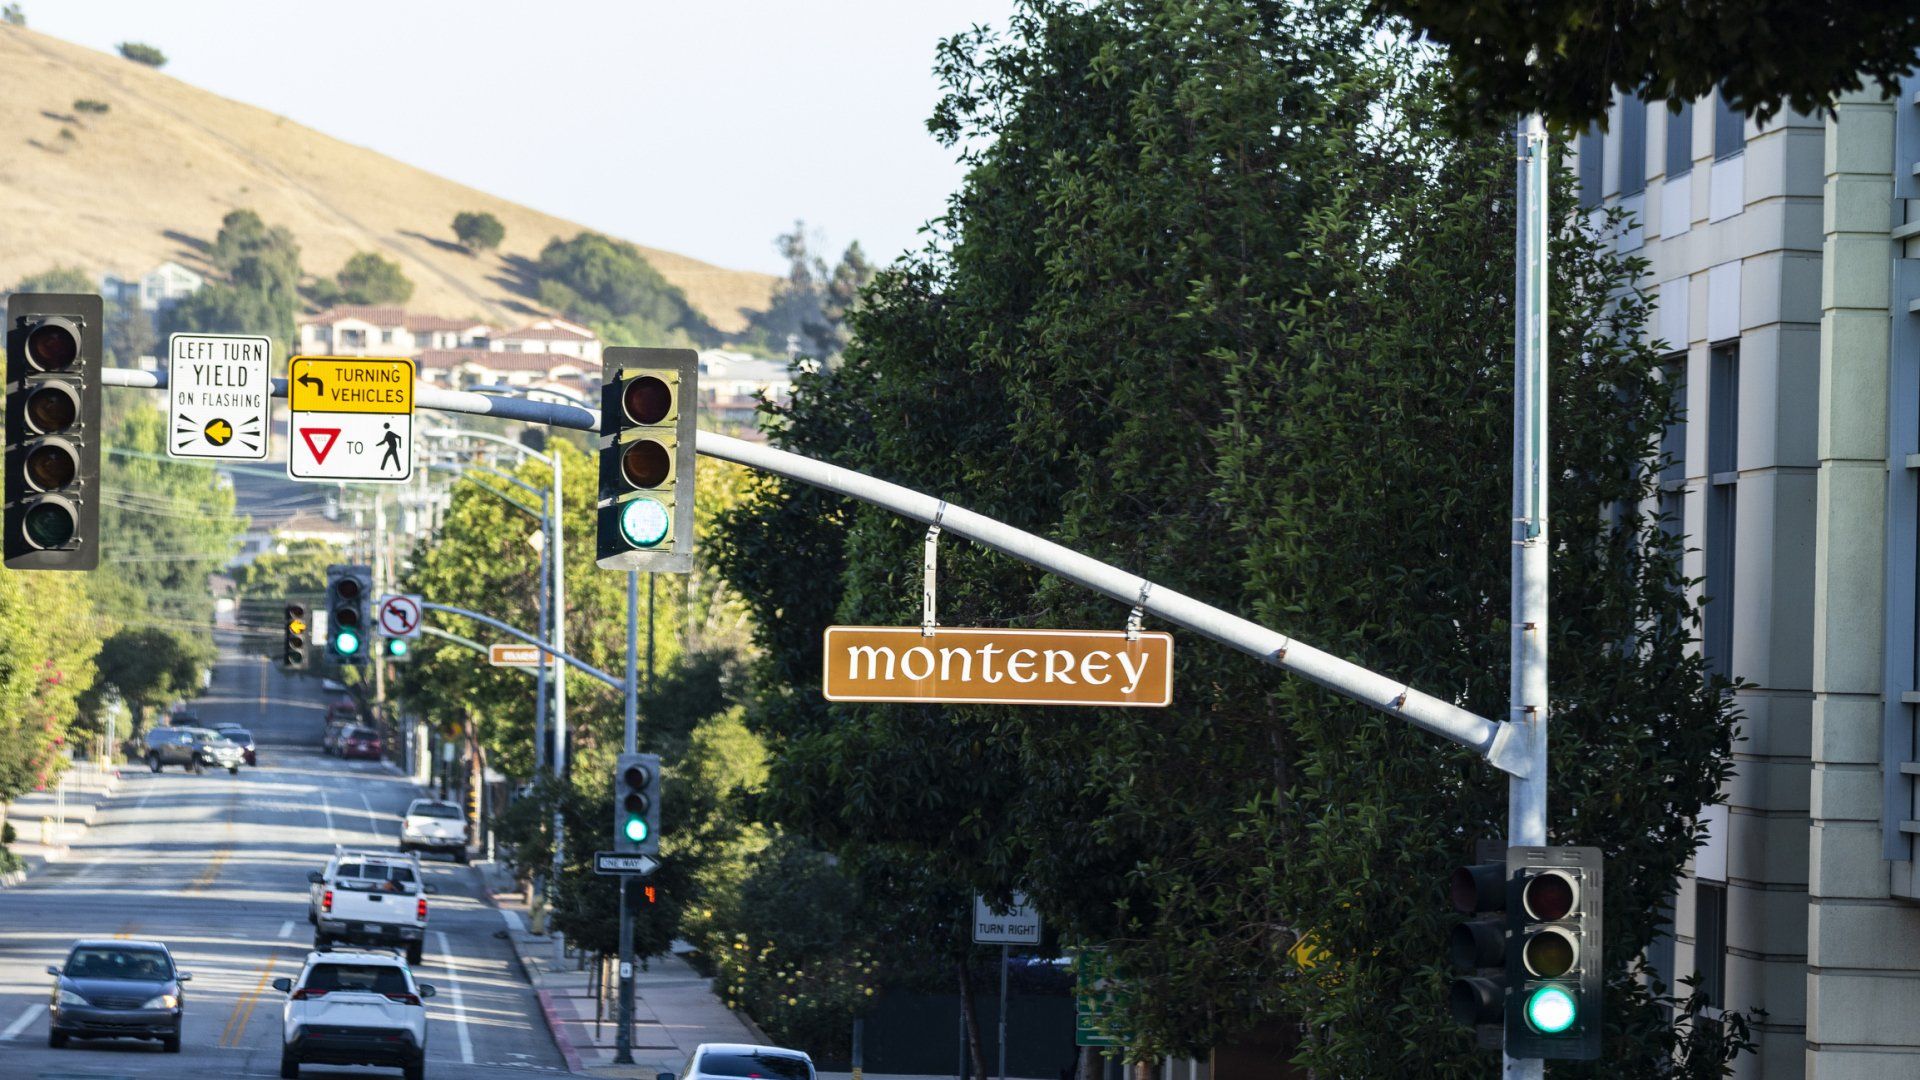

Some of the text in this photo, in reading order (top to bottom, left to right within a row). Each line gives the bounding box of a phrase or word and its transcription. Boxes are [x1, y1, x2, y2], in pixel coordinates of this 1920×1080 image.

[179, 341, 262, 362] LEFT TURN
[193, 364, 248, 388] YIELD
[335, 368, 401, 383] TURNING
[178, 391, 261, 408] ON FLASHING
[331, 388, 404, 403] VEHICLES
[346, 441, 364, 455] TO
[622, 859, 639, 868] WAY
[979, 923, 1036, 936] TURN RIGHT
